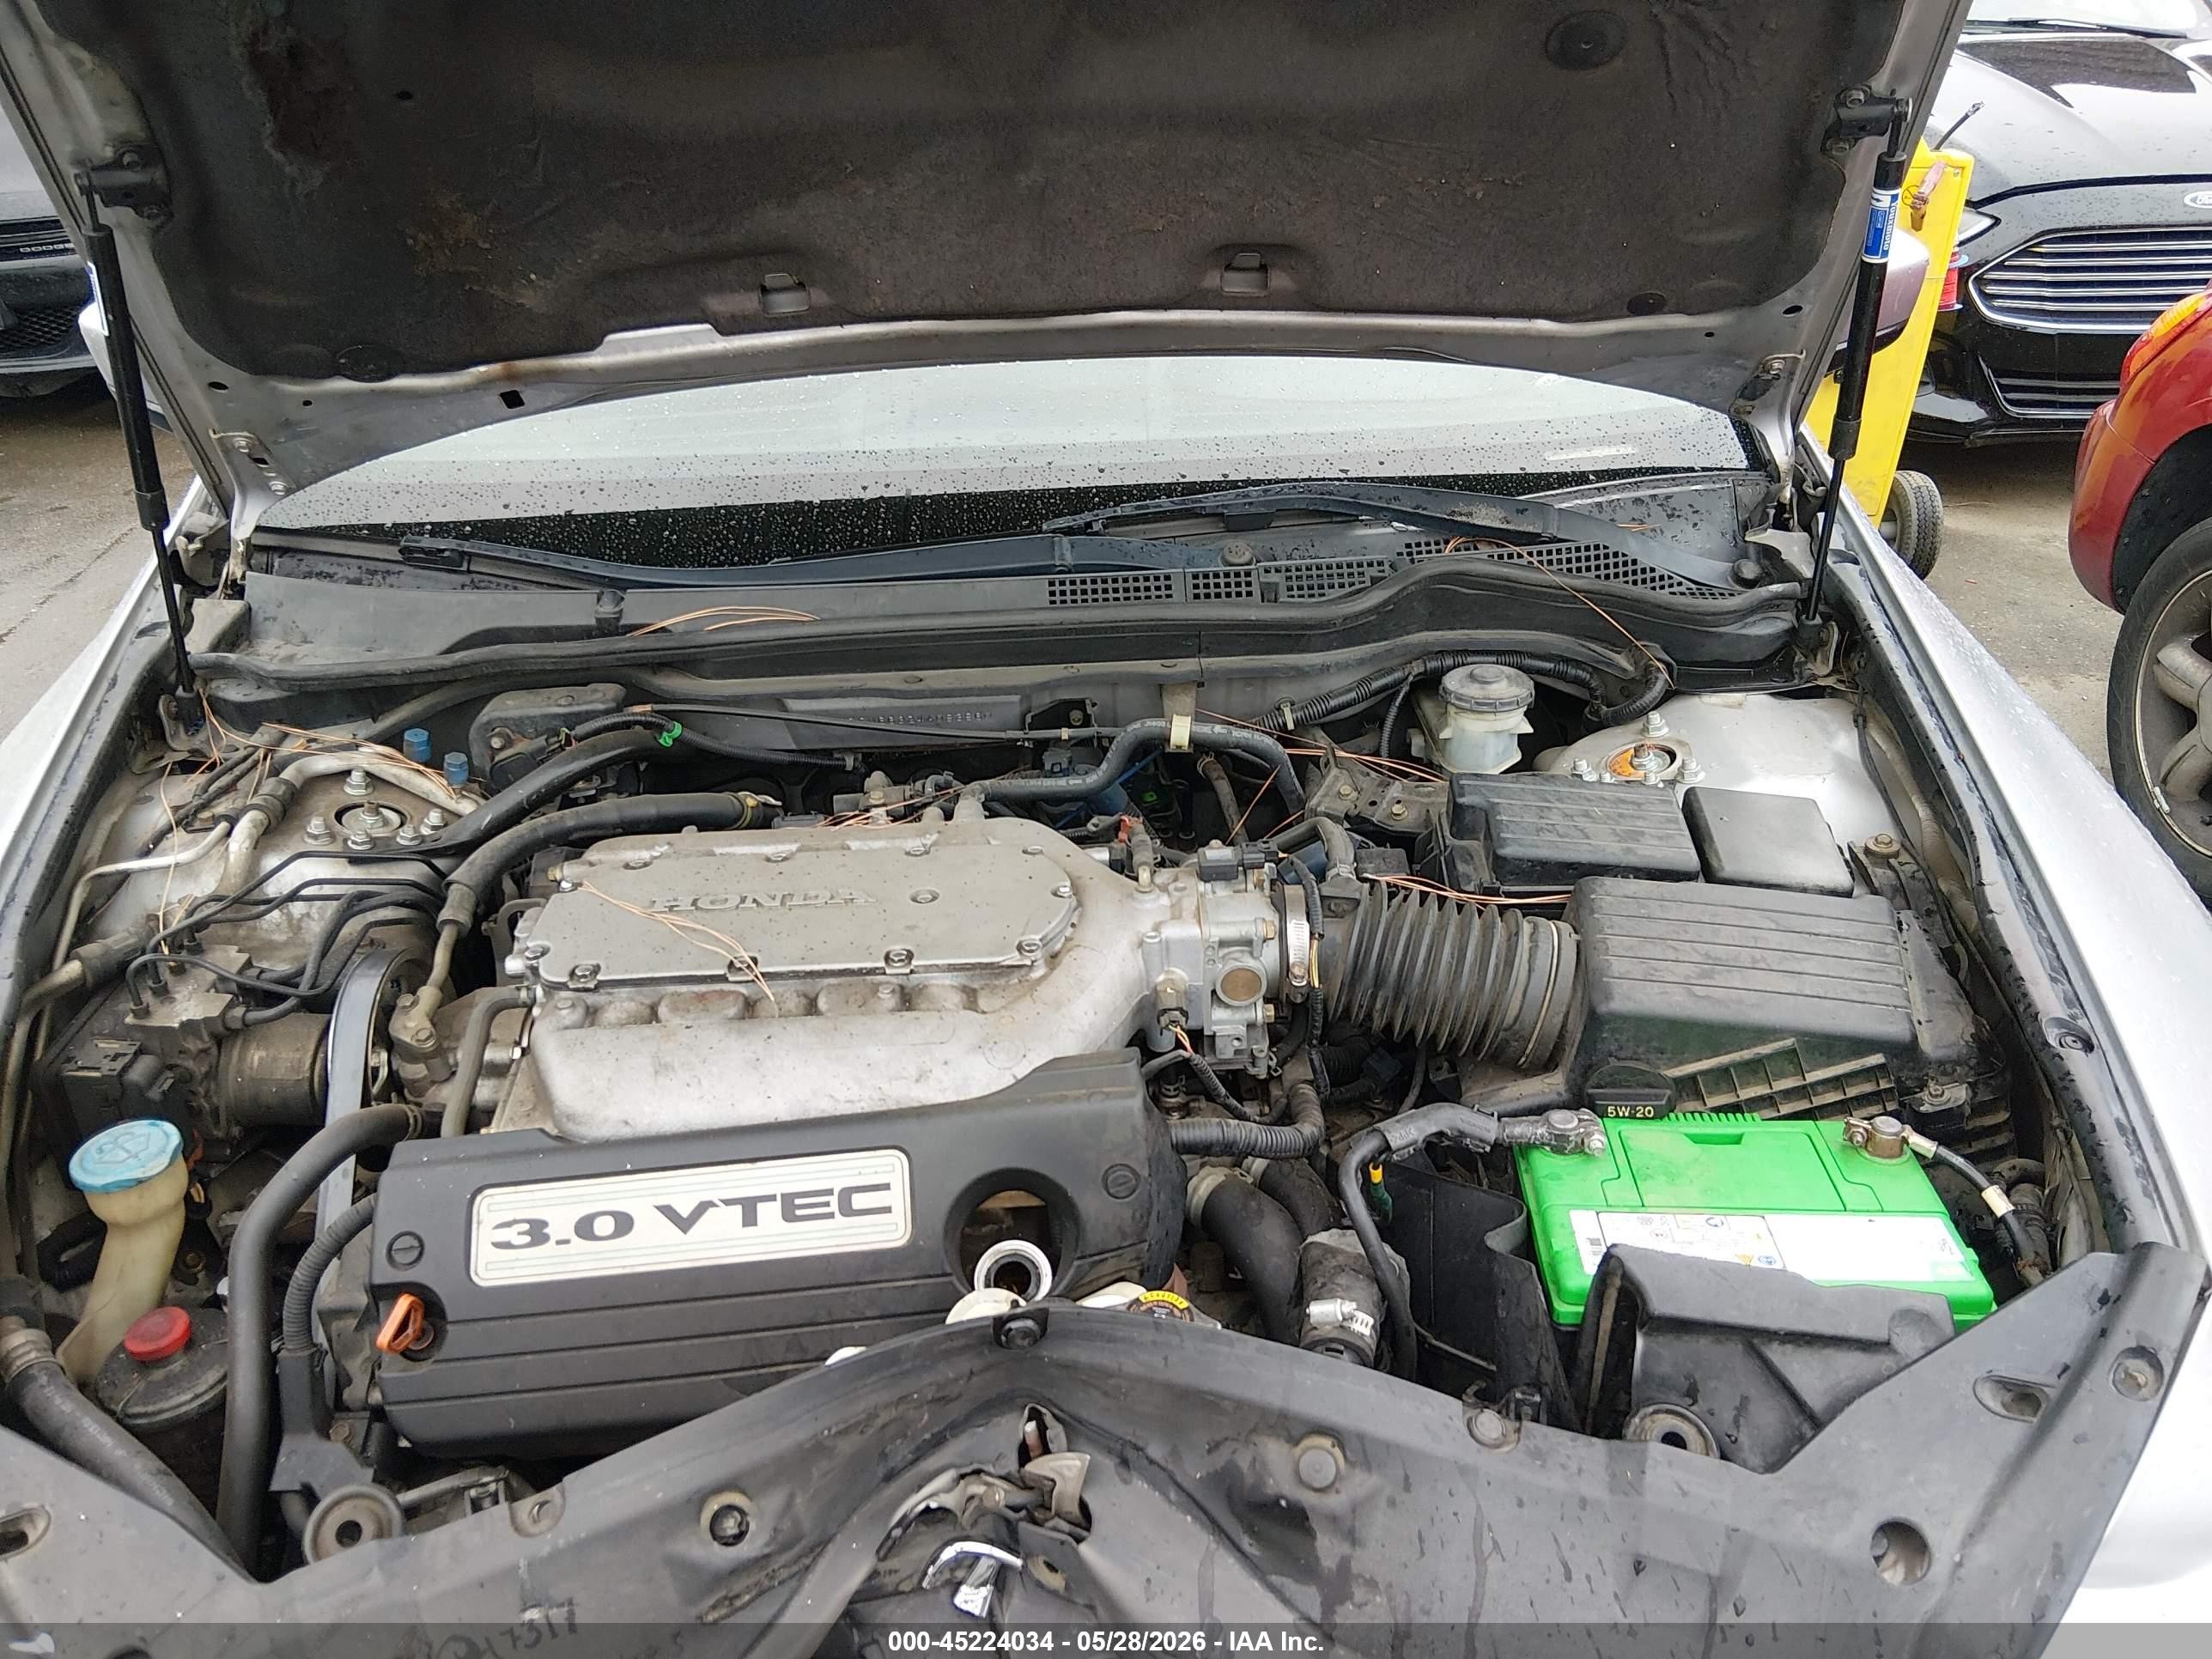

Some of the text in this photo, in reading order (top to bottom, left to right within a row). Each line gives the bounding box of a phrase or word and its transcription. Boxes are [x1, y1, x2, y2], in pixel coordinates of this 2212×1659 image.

[648, 889, 878, 913] HONDA
[1607, 1106, 1654, 1118] 5W-20
[491, 1182, 892, 1250] 3.0 VTEC
